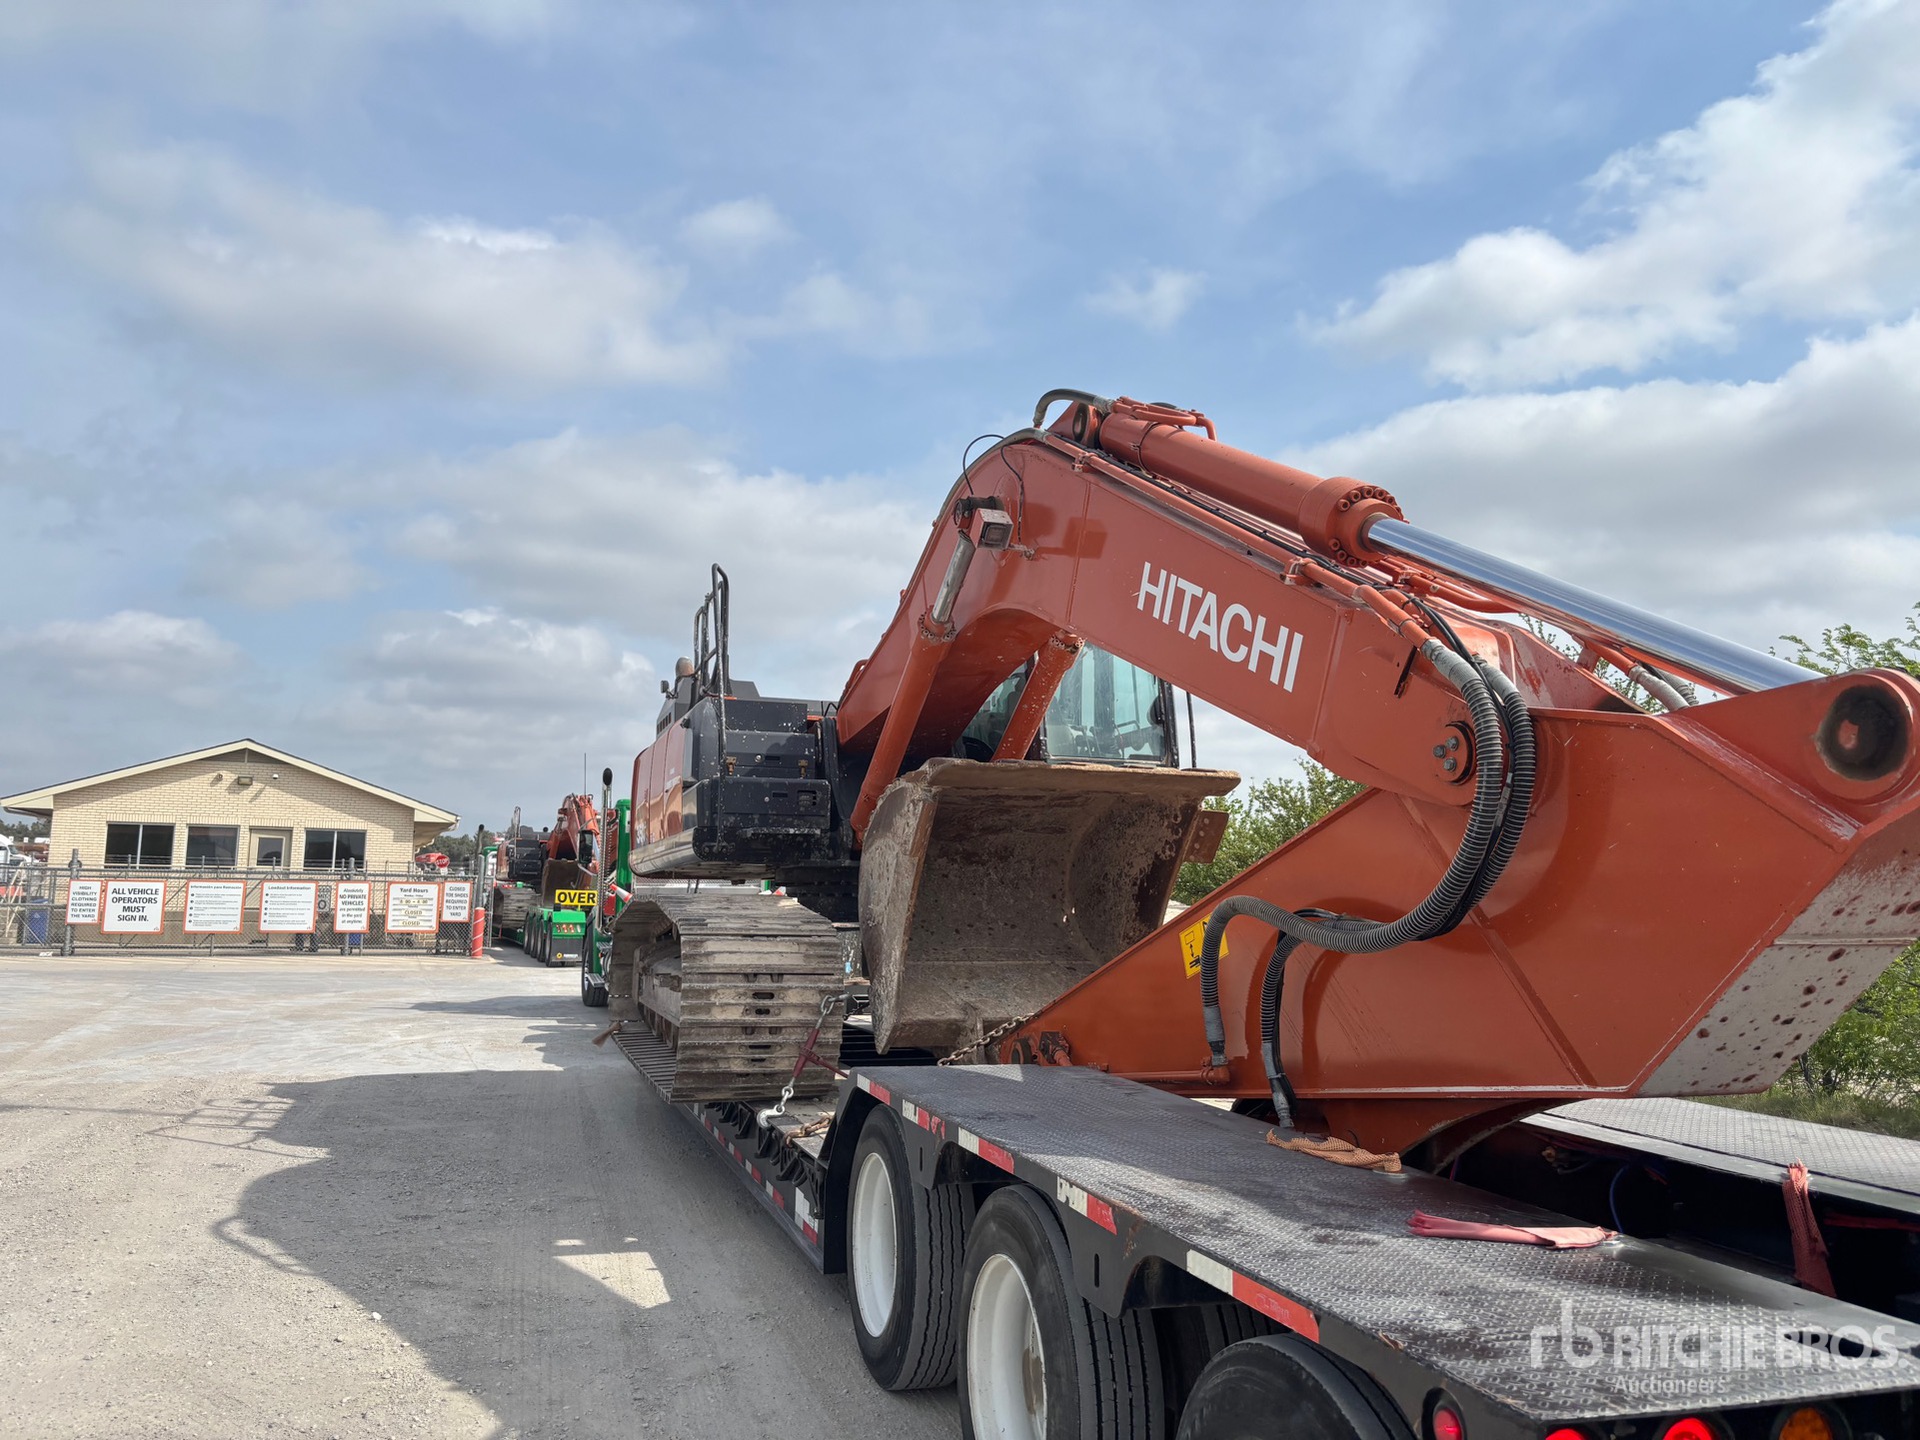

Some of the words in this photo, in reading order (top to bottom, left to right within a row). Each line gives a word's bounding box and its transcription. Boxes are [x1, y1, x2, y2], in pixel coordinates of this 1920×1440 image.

[1136, 561, 1304, 693] HITACHI
[127, 888, 160, 896] VEHICLE
[557, 891, 596, 904] OVER
[117, 914, 137, 922] SIGN
